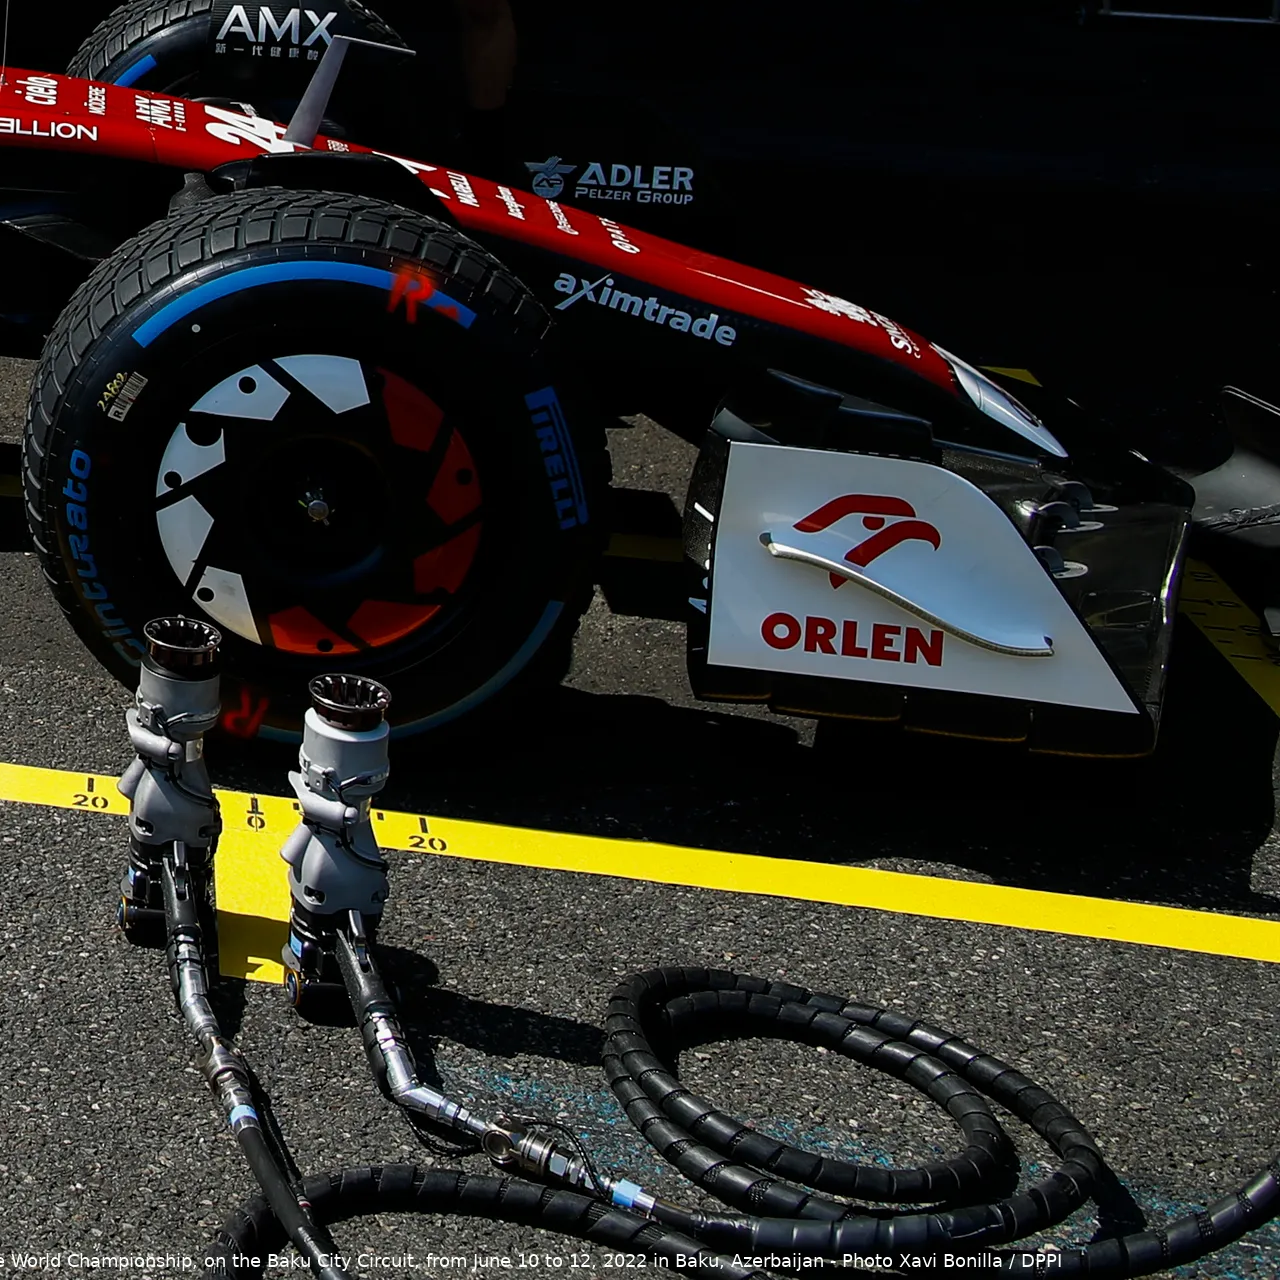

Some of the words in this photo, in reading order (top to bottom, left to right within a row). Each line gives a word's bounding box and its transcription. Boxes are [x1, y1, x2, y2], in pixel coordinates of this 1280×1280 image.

[216, 5, 338, 46] AMX
[15, 76, 58, 106] cielo
[204, 104, 297, 154] 24
[446, 170, 481, 208] MARELLI
[577, 162, 695, 193] ADLER
[553, 271, 737, 348] aximtrade
[525, 386, 588, 530] PIRELLI
[760, 611, 944, 668] ORLEN
[72, 794, 109, 811] 20
[408, 834, 447, 853] 20
